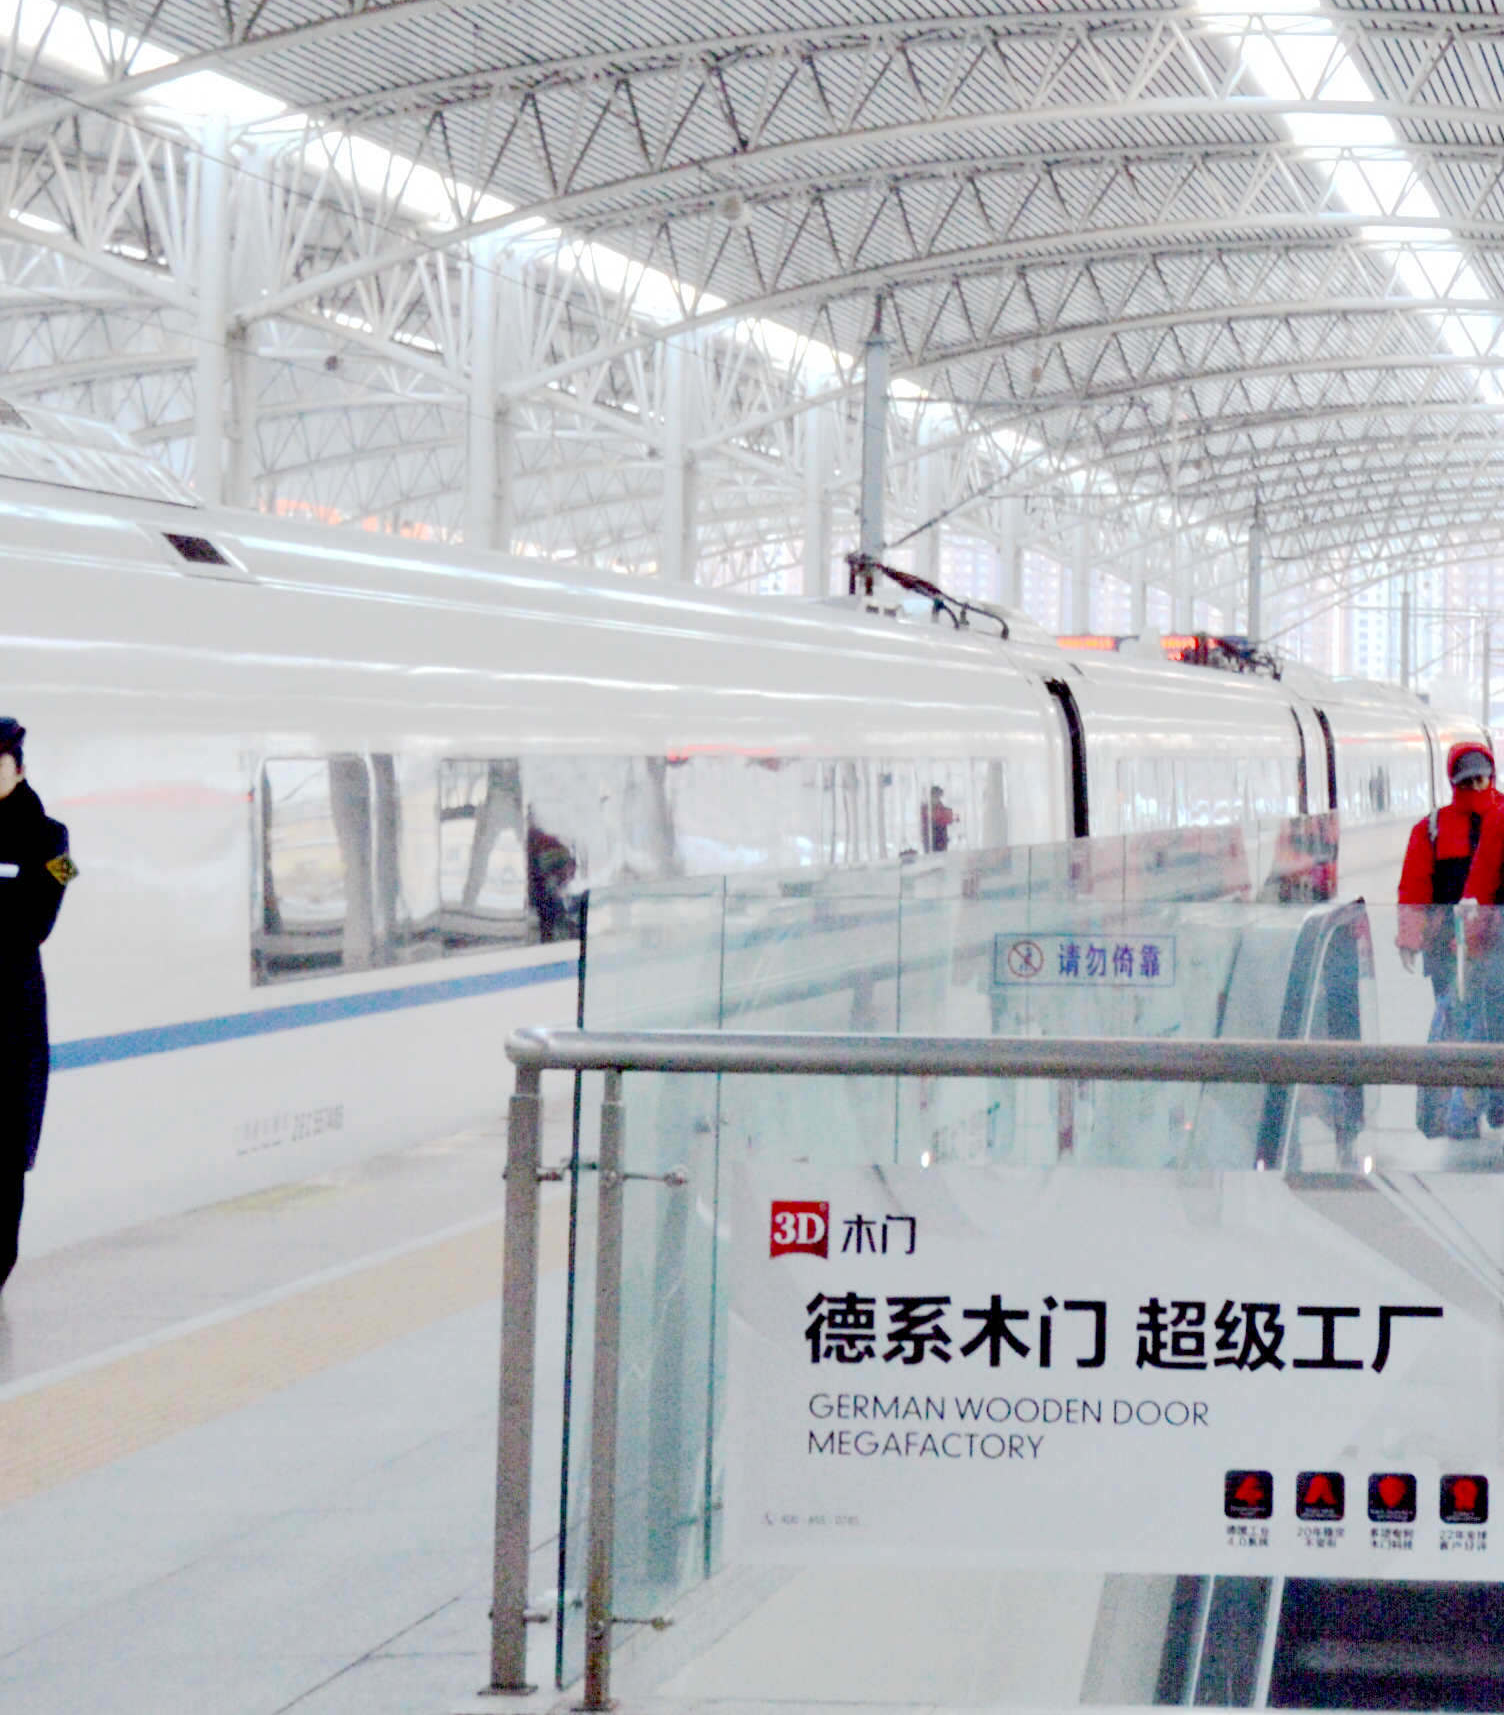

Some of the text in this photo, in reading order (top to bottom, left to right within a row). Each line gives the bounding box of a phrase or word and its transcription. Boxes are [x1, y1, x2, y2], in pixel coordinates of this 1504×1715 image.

[1057, 941, 1161, 979] 请勿倚靠
[772, 1210, 917, 1256] 3D 木门
[804, 1290, 1445, 1375] 德系木门 超级工厂
[808, 1392, 1210, 1428] GERMAN WOODEN DOOR
[807, 1429, 1046, 1461] MEGAFACTORY
